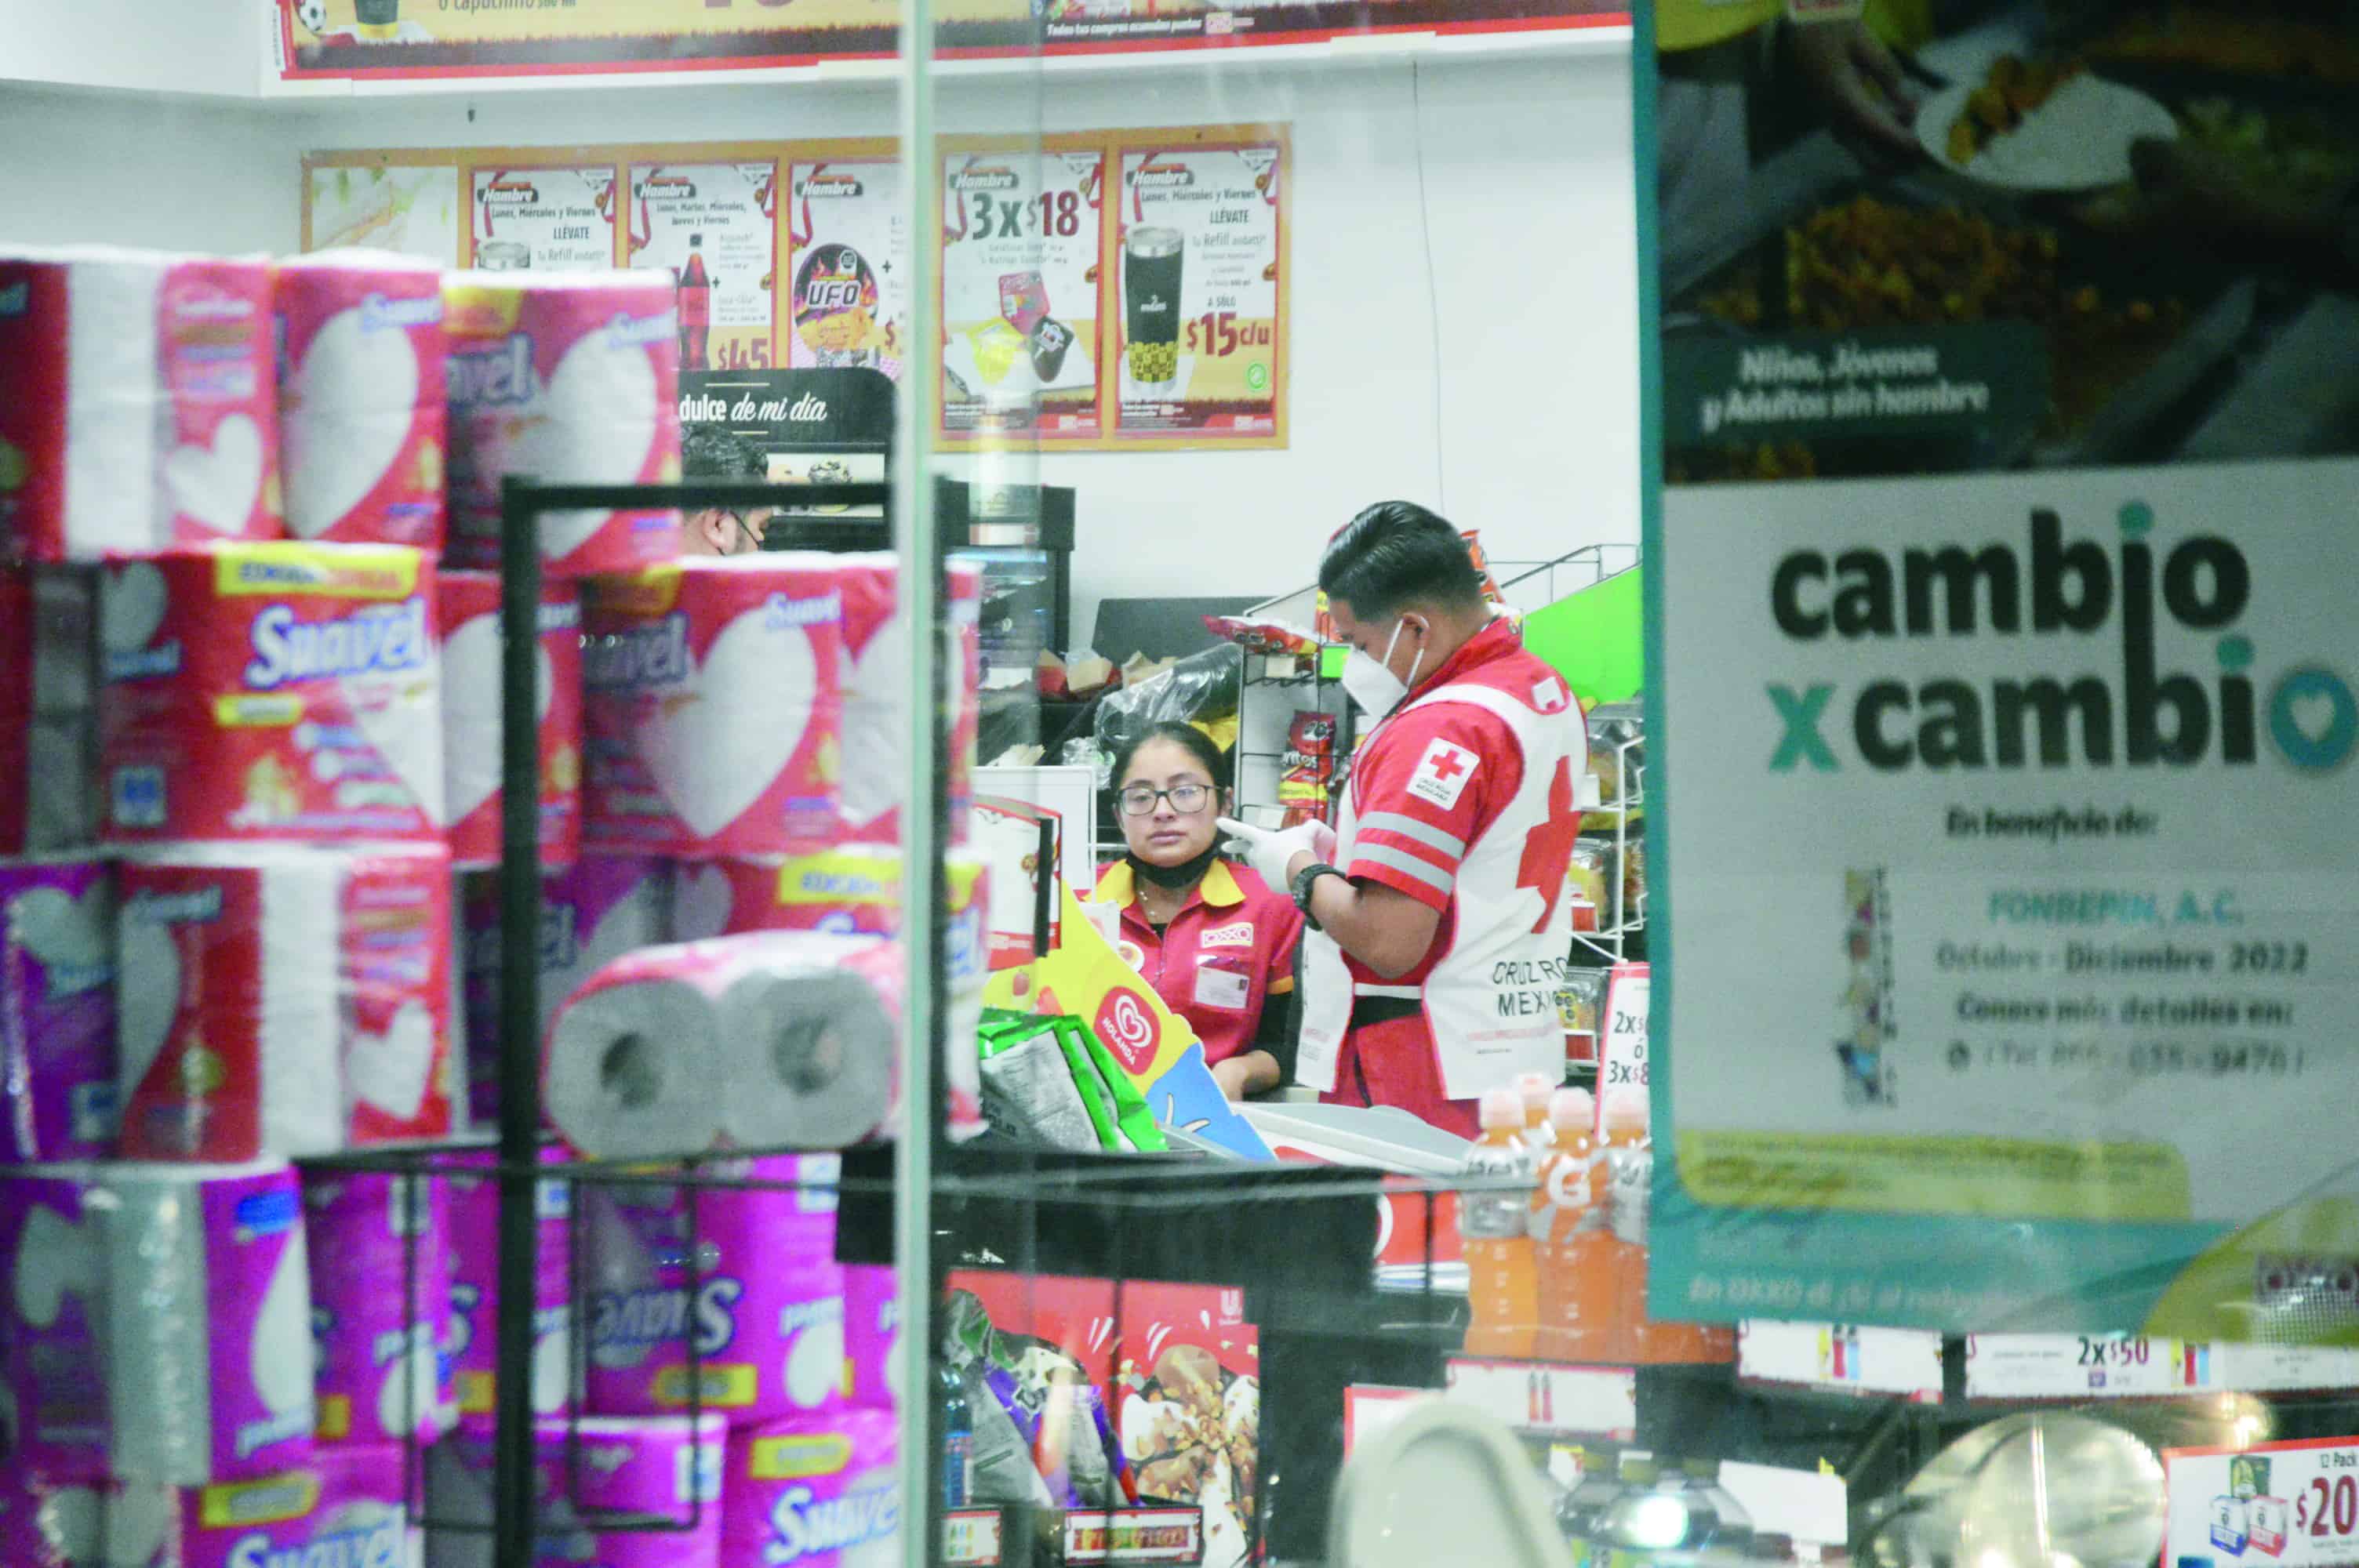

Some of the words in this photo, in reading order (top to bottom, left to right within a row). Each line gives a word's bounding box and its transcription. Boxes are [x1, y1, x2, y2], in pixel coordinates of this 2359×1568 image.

[957, 173, 1013, 188] Hambre
[1132, 169, 1188, 185] Hambre
[483, 188, 534, 202] Hambre
[640, 183, 691, 198] Hambre
[801, 180, 856, 196] Hambre
[492, 206, 516, 220] Lunes,
[519, 205, 556, 218] Miércoles
[566, 206, 595, 217] Viernes
[1210, 205, 1249, 223] LLÉVATE
[553, 223, 590, 239] LLÉVATE
[1204, 233, 1230, 246] Refill
[808, 281, 860, 306] UFO
[718, 339, 769, 369] $45
[680, 394, 727, 421] dulce
[731, 392, 757, 421] de
[758, 397, 787, 421] mi
[790, 391, 827, 421] día
[1772, 501, 2250, 641] cambio
[1205, 926, 1251, 945] OXXO
[1493, 961, 1539, 985] CRUZ
[1614, 1011, 1648, 1034] 2x$
[1102, 1018, 1136, 1065] HOLANDA
[1547, 1155, 1592, 1207] G
